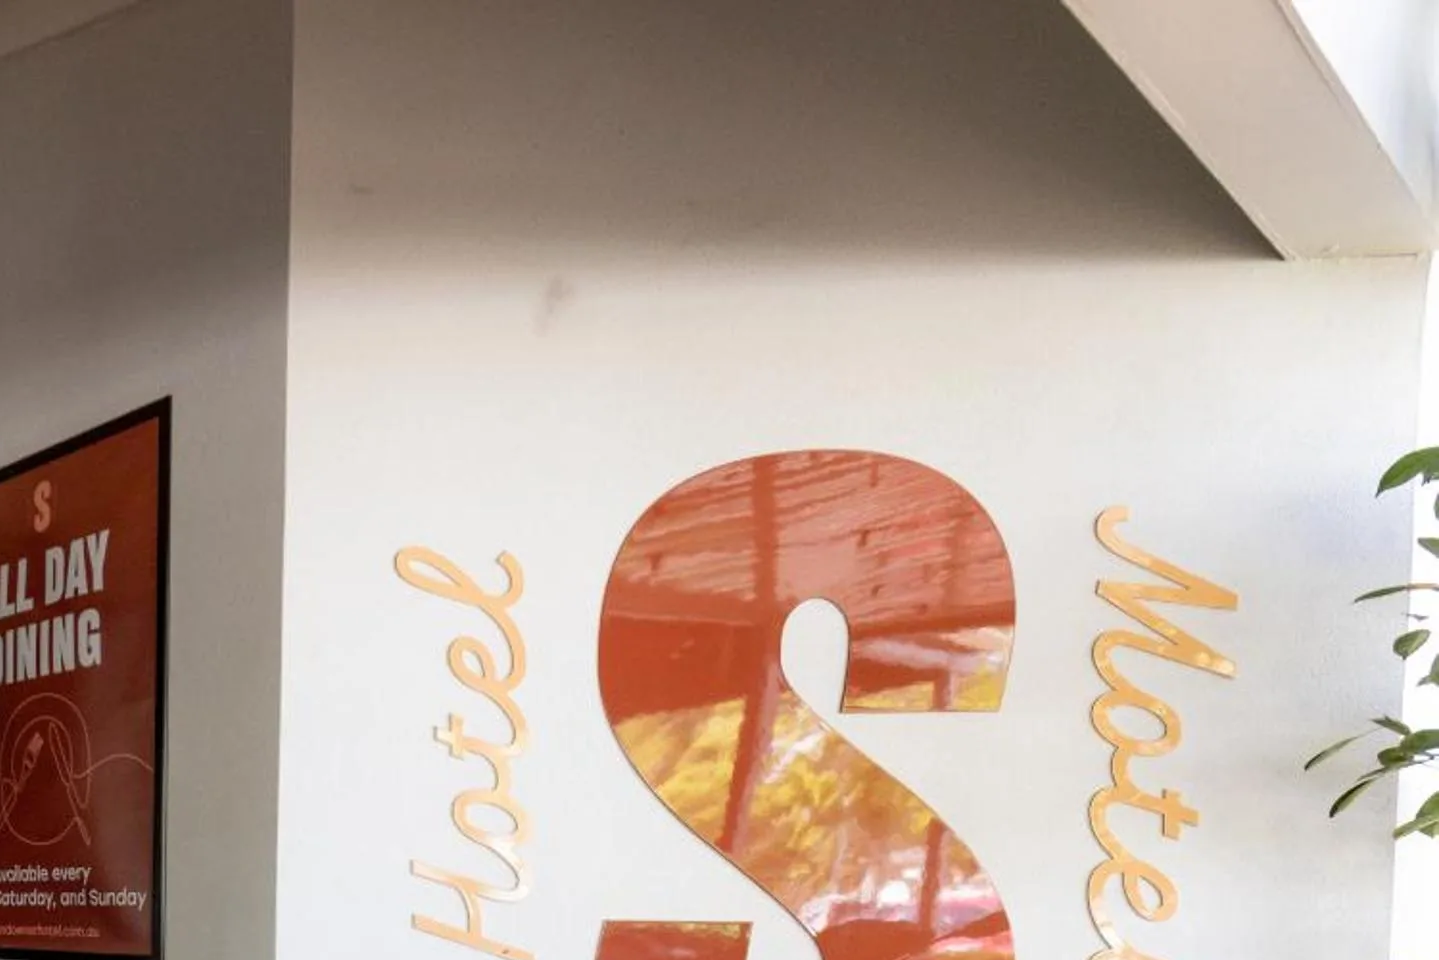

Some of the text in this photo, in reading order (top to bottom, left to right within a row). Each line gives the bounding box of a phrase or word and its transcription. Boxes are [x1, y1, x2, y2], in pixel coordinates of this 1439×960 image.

[33, 480, 52, 533] S
[45, 529, 110, 605] DAY
[52, 865, 92, 884] every
[60, 889, 87, 907] and
[88, 887, 148, 911] Sunday
